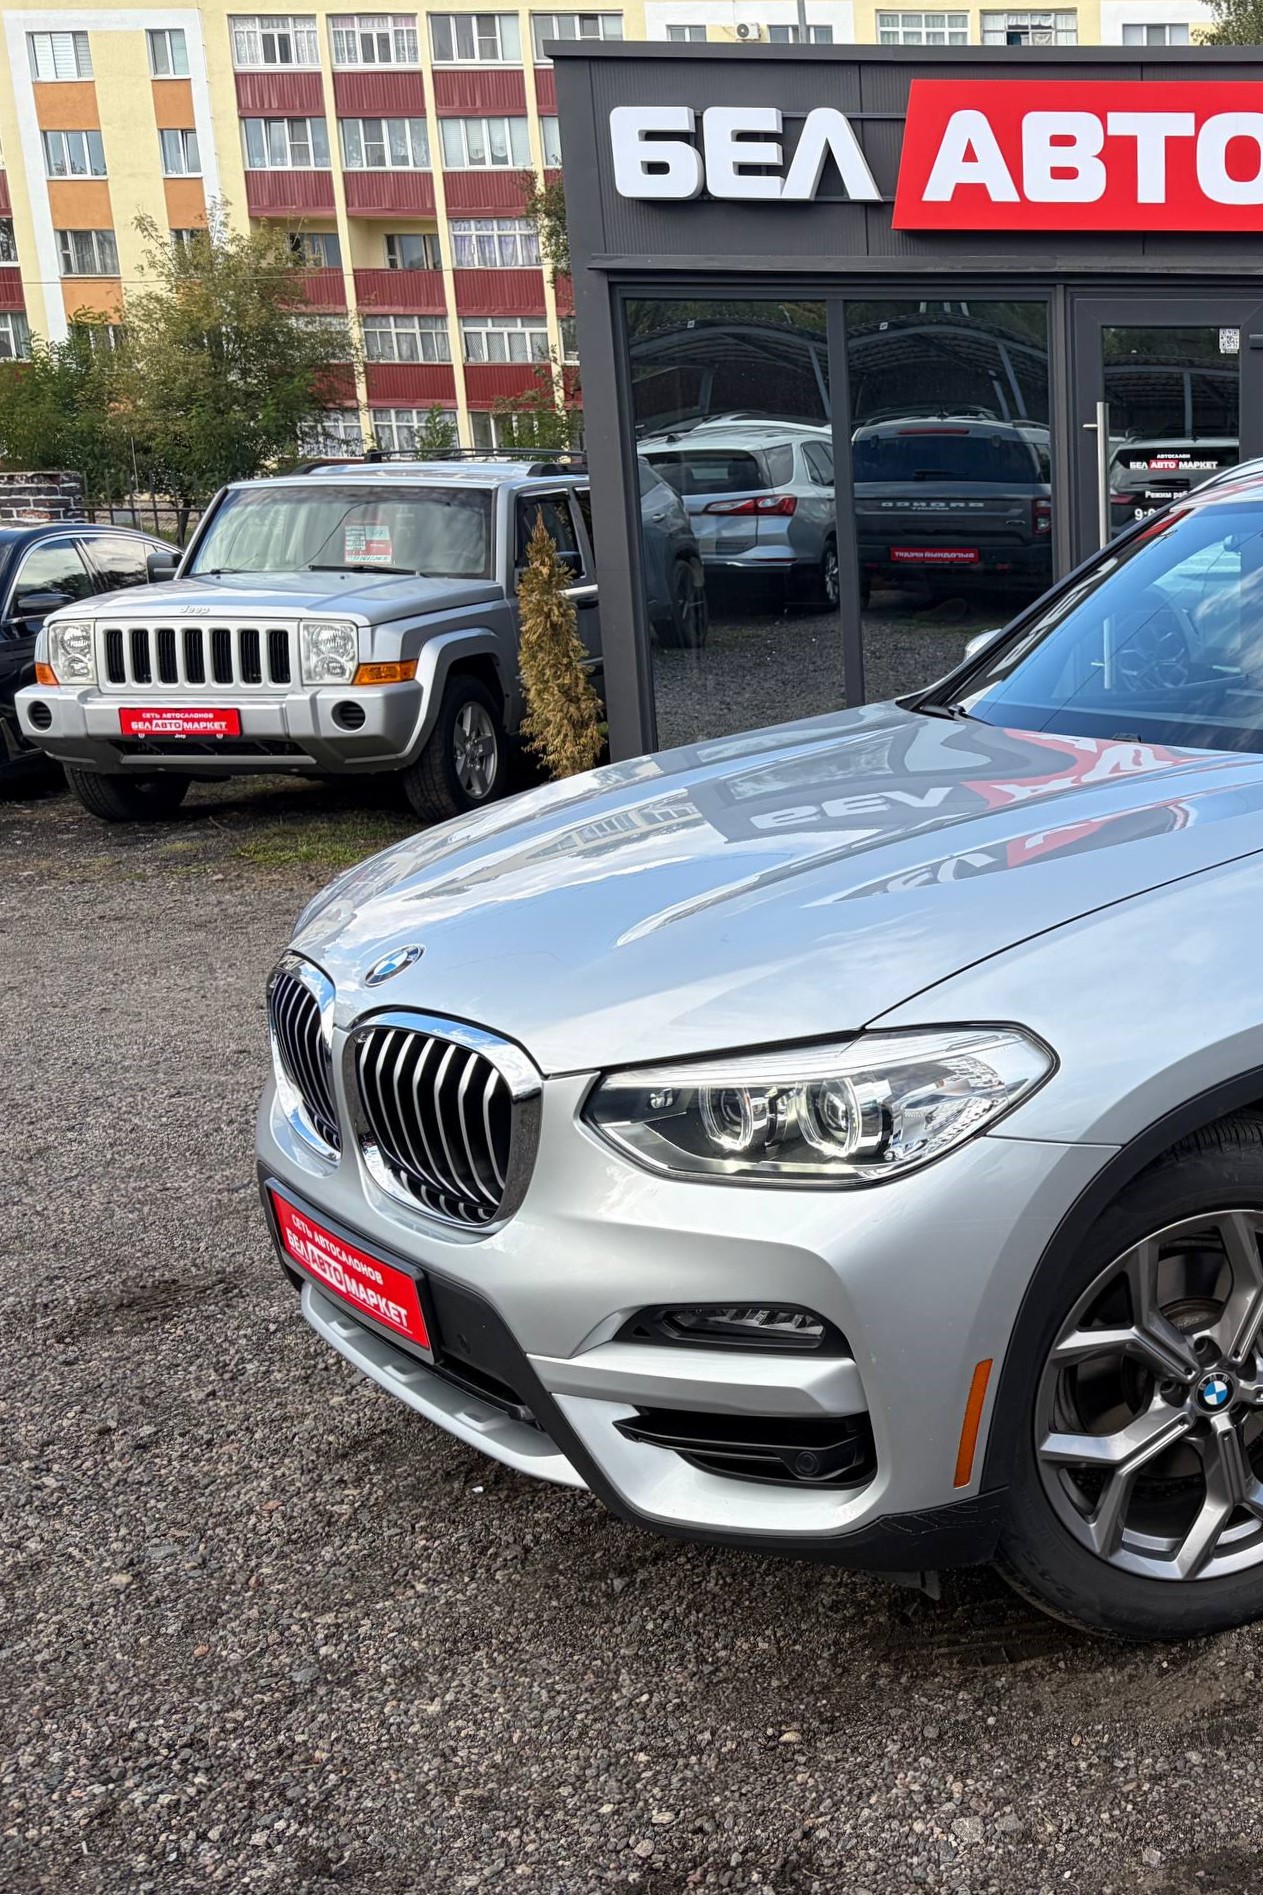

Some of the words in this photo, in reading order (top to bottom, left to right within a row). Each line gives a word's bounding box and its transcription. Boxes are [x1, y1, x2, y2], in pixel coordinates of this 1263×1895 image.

[609, 106, 884, 201] БЕЛ
[1129, 461, 1149, 469] БЕЛ
[1150, 461, 1177, 469] АВТО
[1178, 461, 1218, 469] МАРКЕТ
[1145, 490, 1172, 498] Режим
[180, 605, 210, 614] Jeep
[291, 1213, 313, 1239] СЕТЬ
[314, 1231, 384, 1285] АВТОСАЛОНОВ
